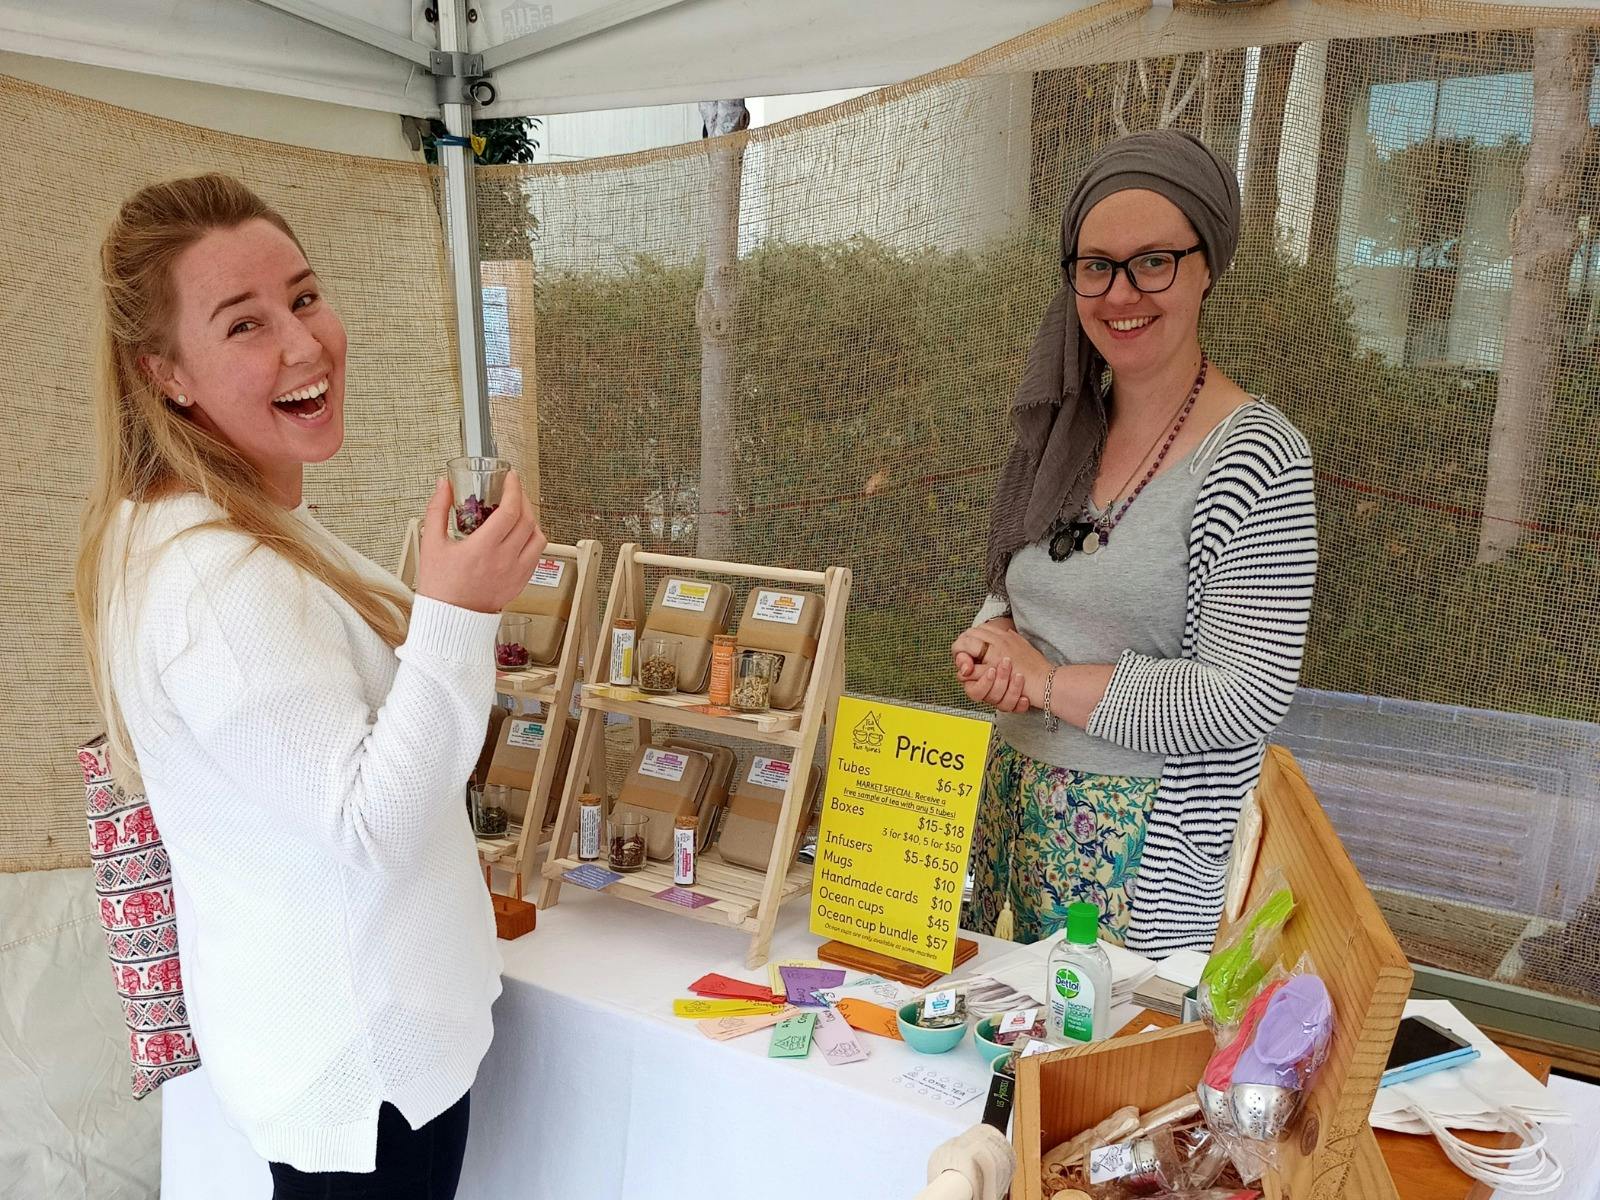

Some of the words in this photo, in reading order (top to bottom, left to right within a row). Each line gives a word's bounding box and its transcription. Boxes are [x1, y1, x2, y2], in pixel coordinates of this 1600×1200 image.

[895, 735, 965, 771] Prices
[838, 757, 871, 776] Tubes
[936, 778, 973, 797] $6-$7
[856, 780, 883, 792] MARKET
[914, 792, 940, 805] Receive
[831, 797, 865, 816] Boxes
[917, 816, 965, 839] $15-$18
[843, 788, 857, 797] free
[857, 791, 880, 803] sample
[881, 795, 889, 803] of
[889, 796, 899, 806] tea
[900, 800, 915, 810] with
[915, 805, 929, 814] any
[935, 808, 957, 818] tubes!
[825, 830, 873, 853] Infusers
[903, 849, 959, 874] $5-$6.50
[881, 828, 888, 836] 3
[889, 828, 902, 839] for
[903, 831, 920, 845] $40,
[922, 837, 929, 845] 5
[930, 839, 942, 849] for
[945, 841, 962, 854] $50
[821, 868, 883, 895] Handmade
[885, 887, 919, 904] cards
[930, 895, 953, 913] $10
[823, 849, 853, 868] Mugs
[933, 876, 956, 893] $10
[817, 904, 853, 925] Ocean
[855, 918, 876, 933] cup
[879, 921, 919, 943] bundle
[926, 934, 948, 951] $57
[819, 886, 855, 907] Ocean
[857, 900, 884, 915] cups
[927, 914, 950, 933] $45
[824, 922, 840, 932] Ocean
[916, 950, 937, 960] markets
[1055, 976, 1080, 991] Dettol
